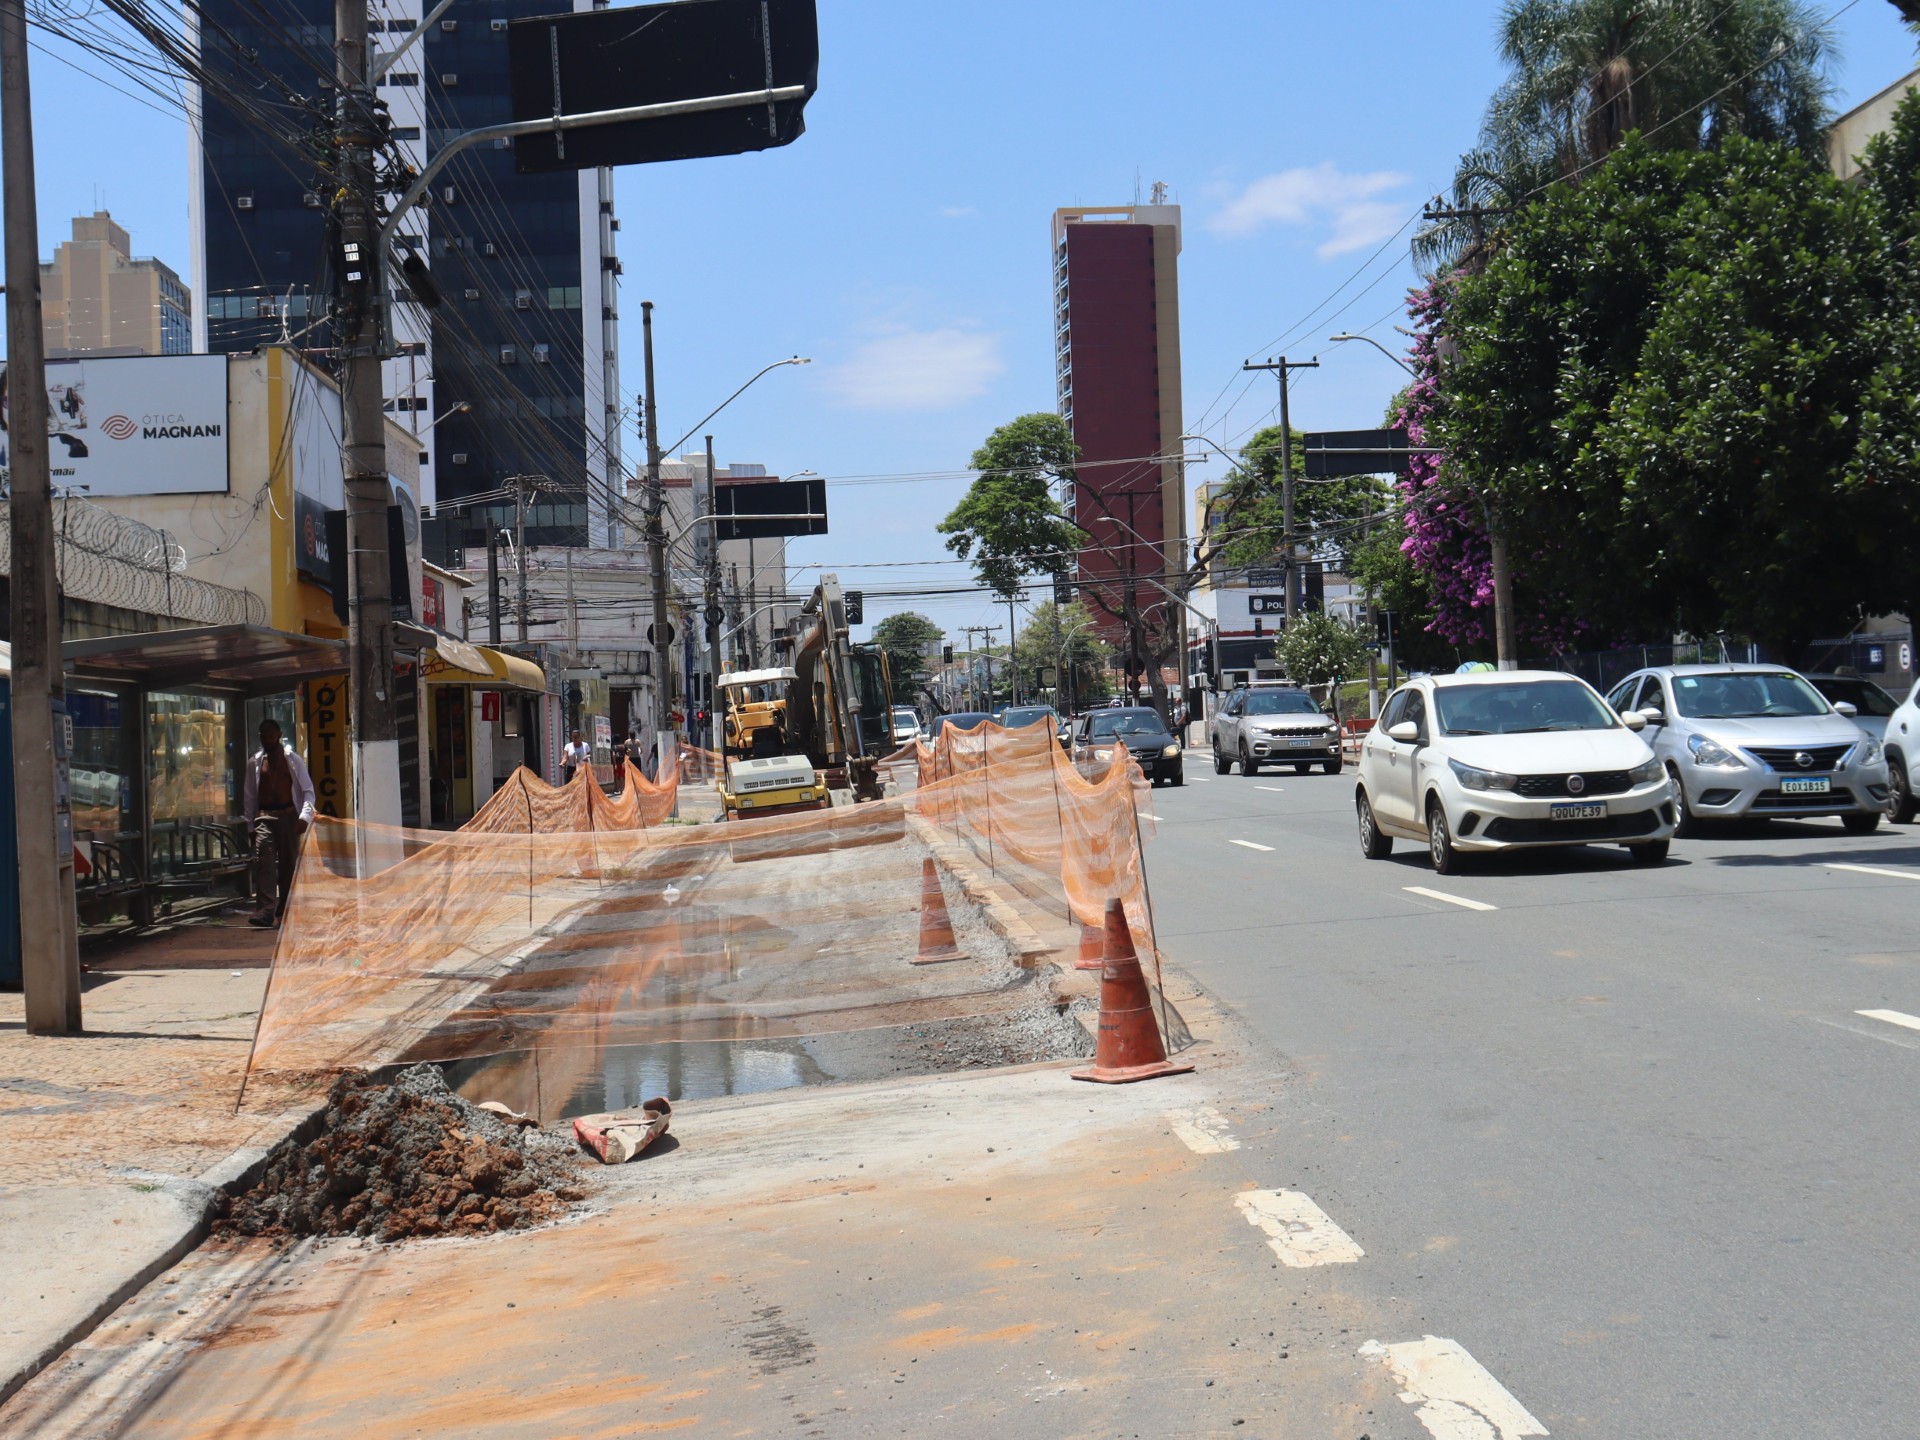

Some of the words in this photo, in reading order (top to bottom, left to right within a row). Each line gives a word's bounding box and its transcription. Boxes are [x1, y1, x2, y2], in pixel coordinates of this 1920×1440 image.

[142, 413, 185, 425] ÓTICA
[142, 424, 221, 439] MAGNANI
[316, 682, 338, 818] ÓPTICA
